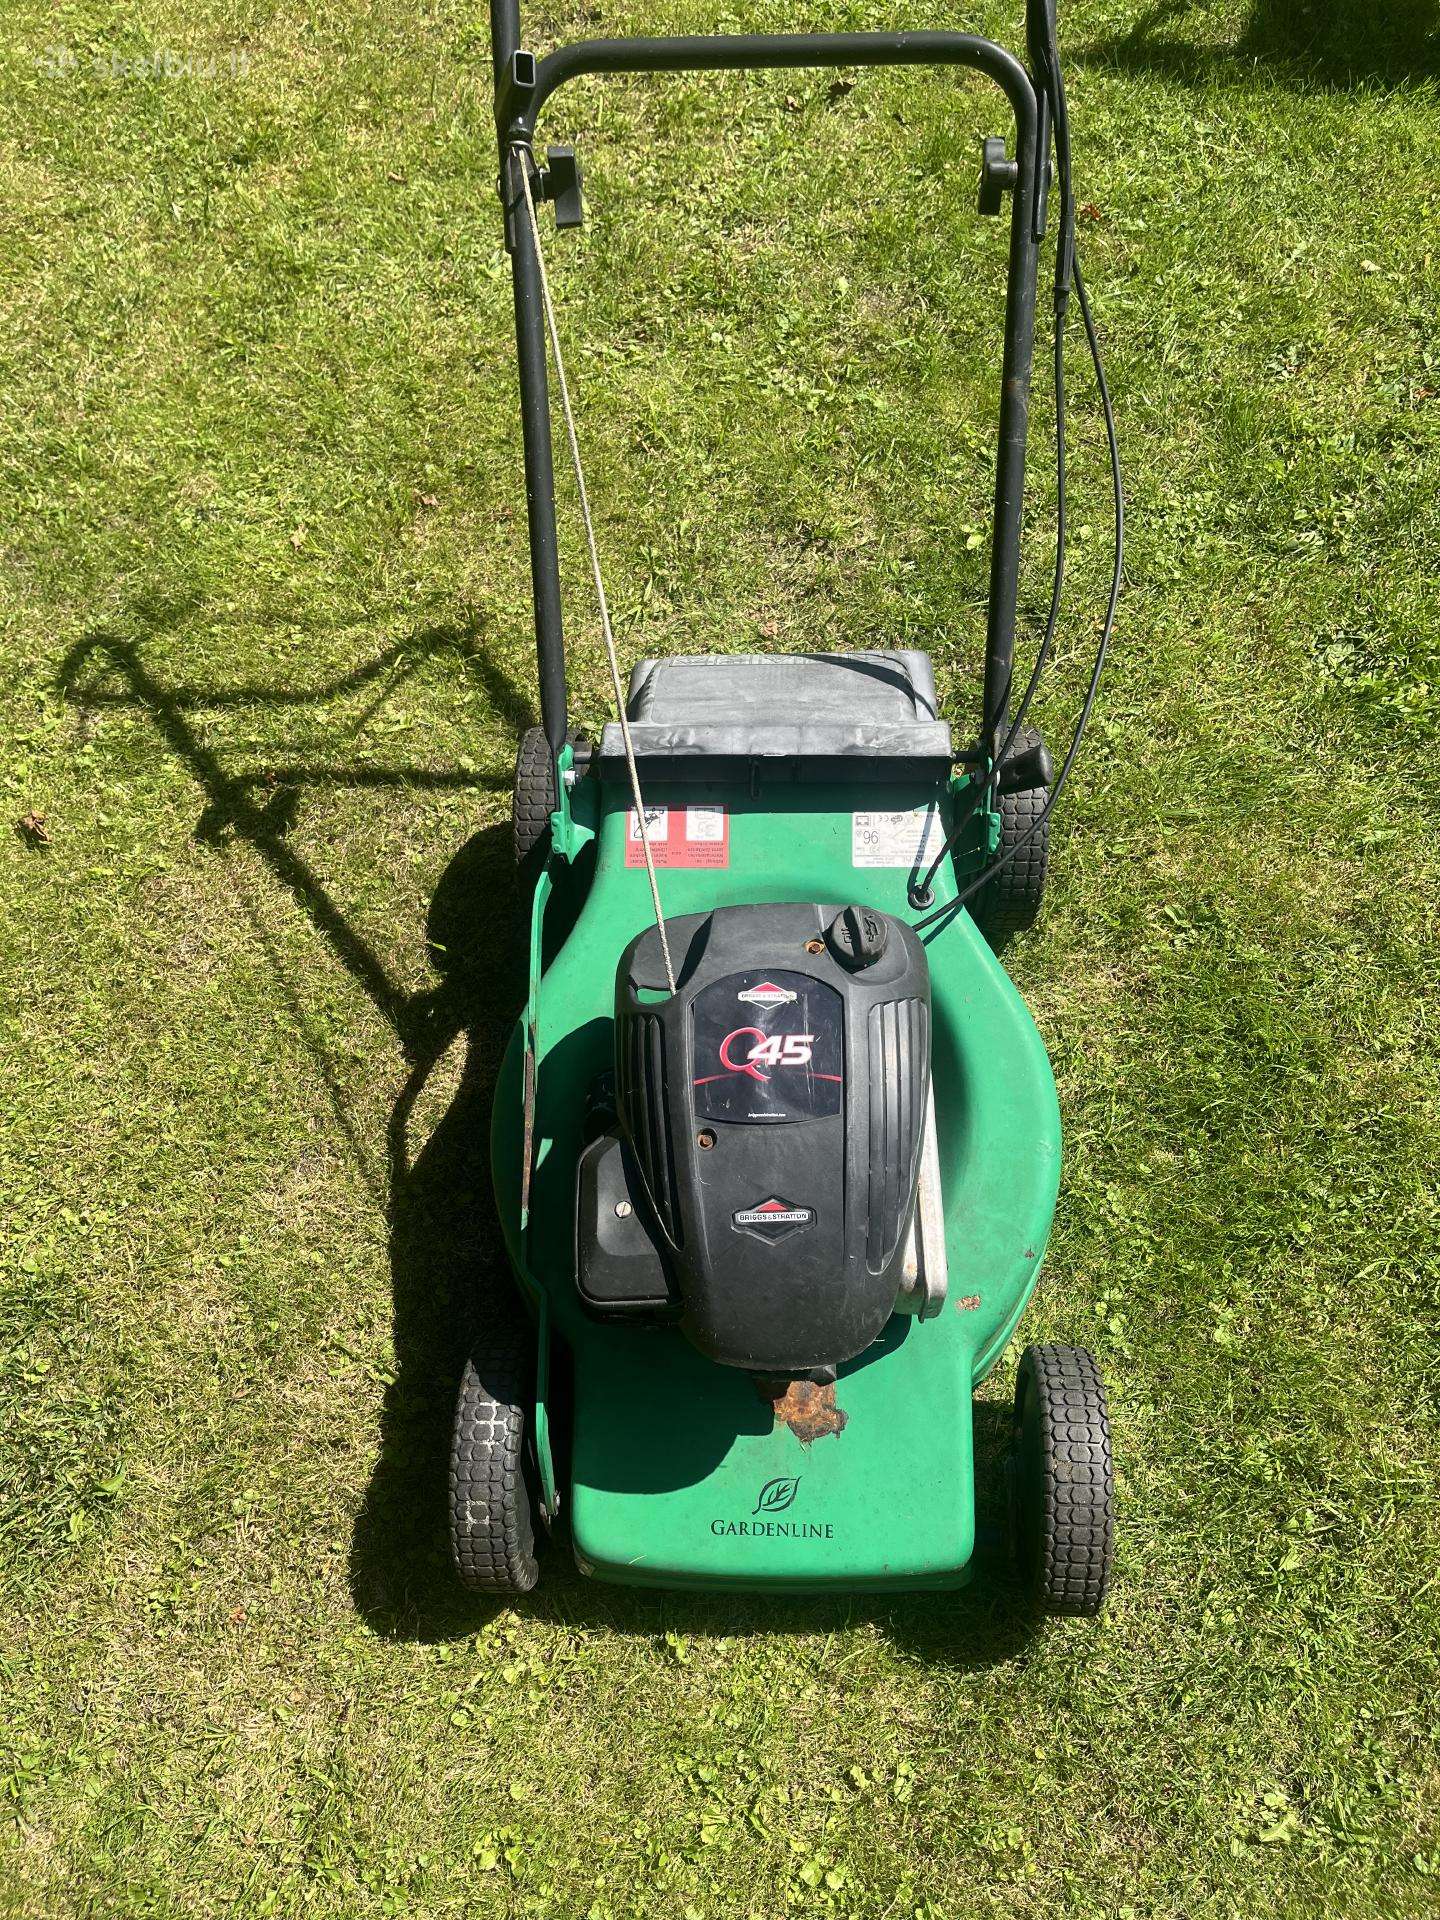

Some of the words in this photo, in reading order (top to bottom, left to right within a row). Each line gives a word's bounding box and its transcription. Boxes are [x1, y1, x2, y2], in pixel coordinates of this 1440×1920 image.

[863, 830, 879, 845] 96
[719, 1027, 814, 1083] Q45
[711, 1519, 834, 1539] GARDENLINE
